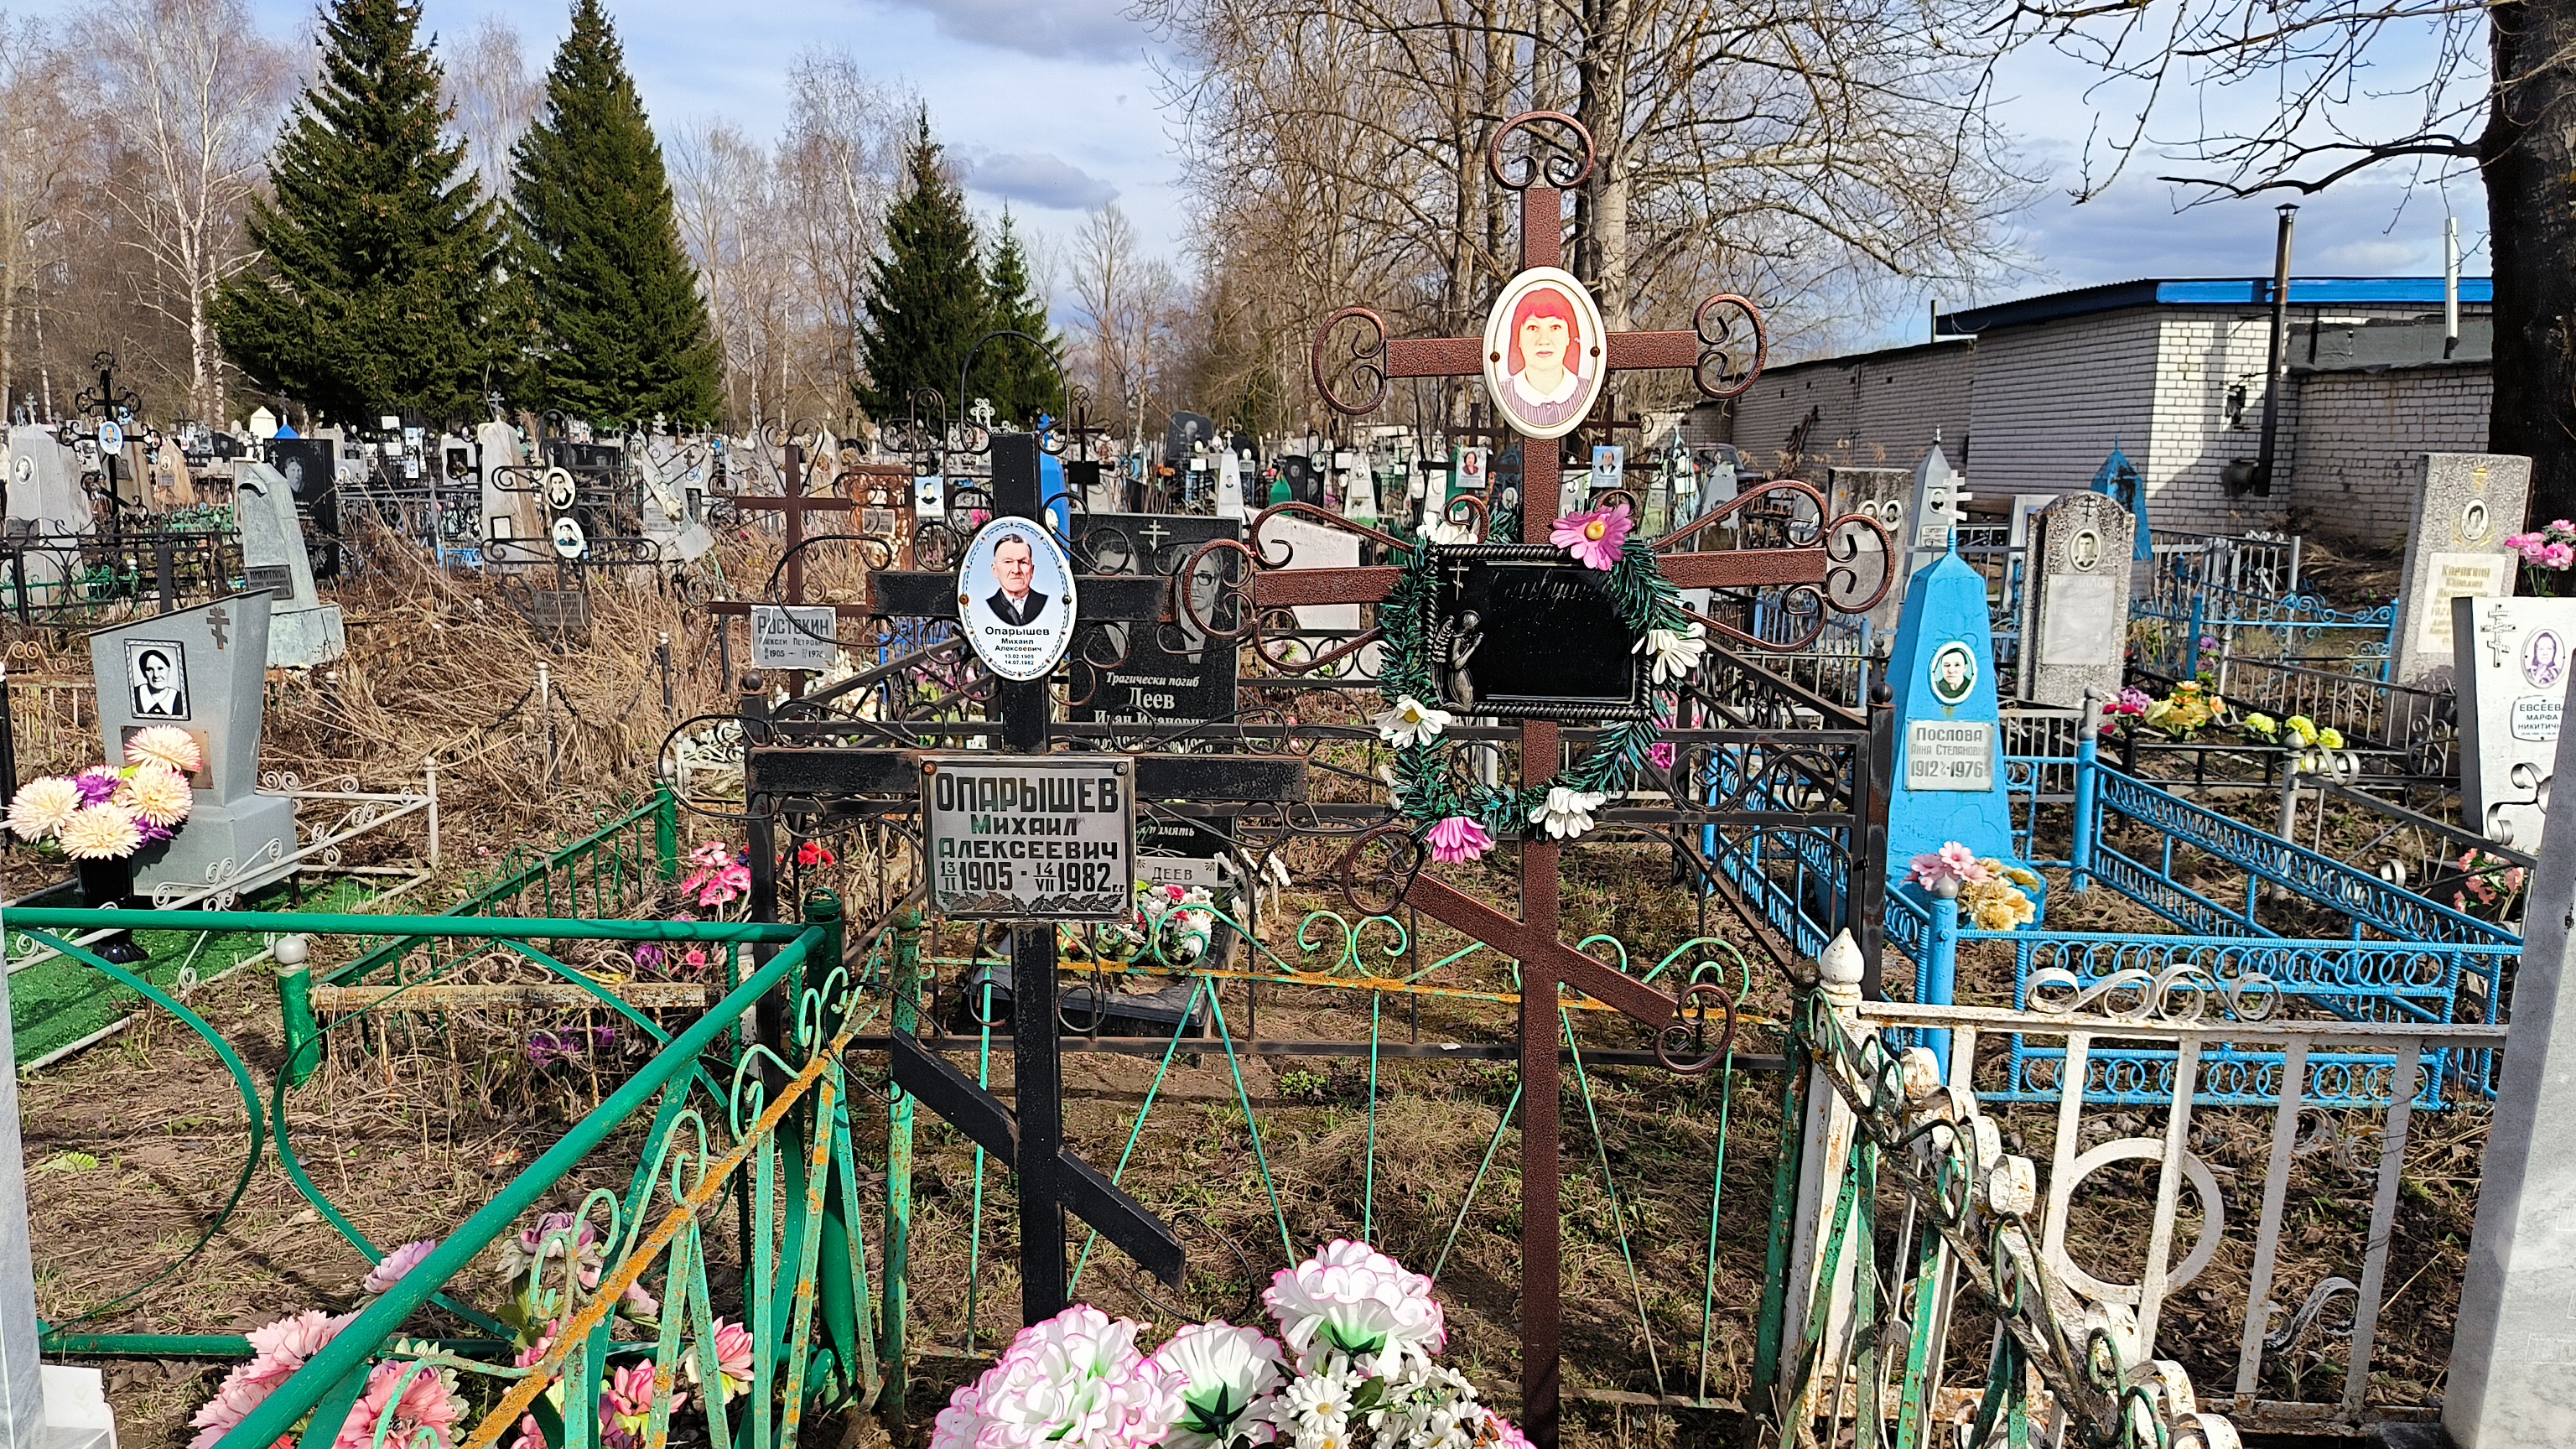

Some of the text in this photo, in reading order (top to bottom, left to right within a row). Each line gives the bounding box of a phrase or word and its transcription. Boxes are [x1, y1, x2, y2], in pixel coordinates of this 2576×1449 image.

[985, 626, 1050, 636] Опарышев
[793, 638, 828, 647] ПЕТРОВИ
[1106, 672, 1200, 687] Трагически погиб
[1916, 727, 1982, 741] ПОСЛОВА
[1910, 744, 1932, 756] АННА
[1910, 760, 1938, 776] 1912
[1950, 761, 1984, 777] 1976
[936, 772, 1119, 813] ОПАРЫШЕВ
[970, 814, 1078, 836] МИХАИЛ
[938, 837, 1119, 860] АЛЕКСЕЕВИЧ
[959, 861, 1013, 891] 1905
[1152, 867, 1192, 881] ДЕЕВ
